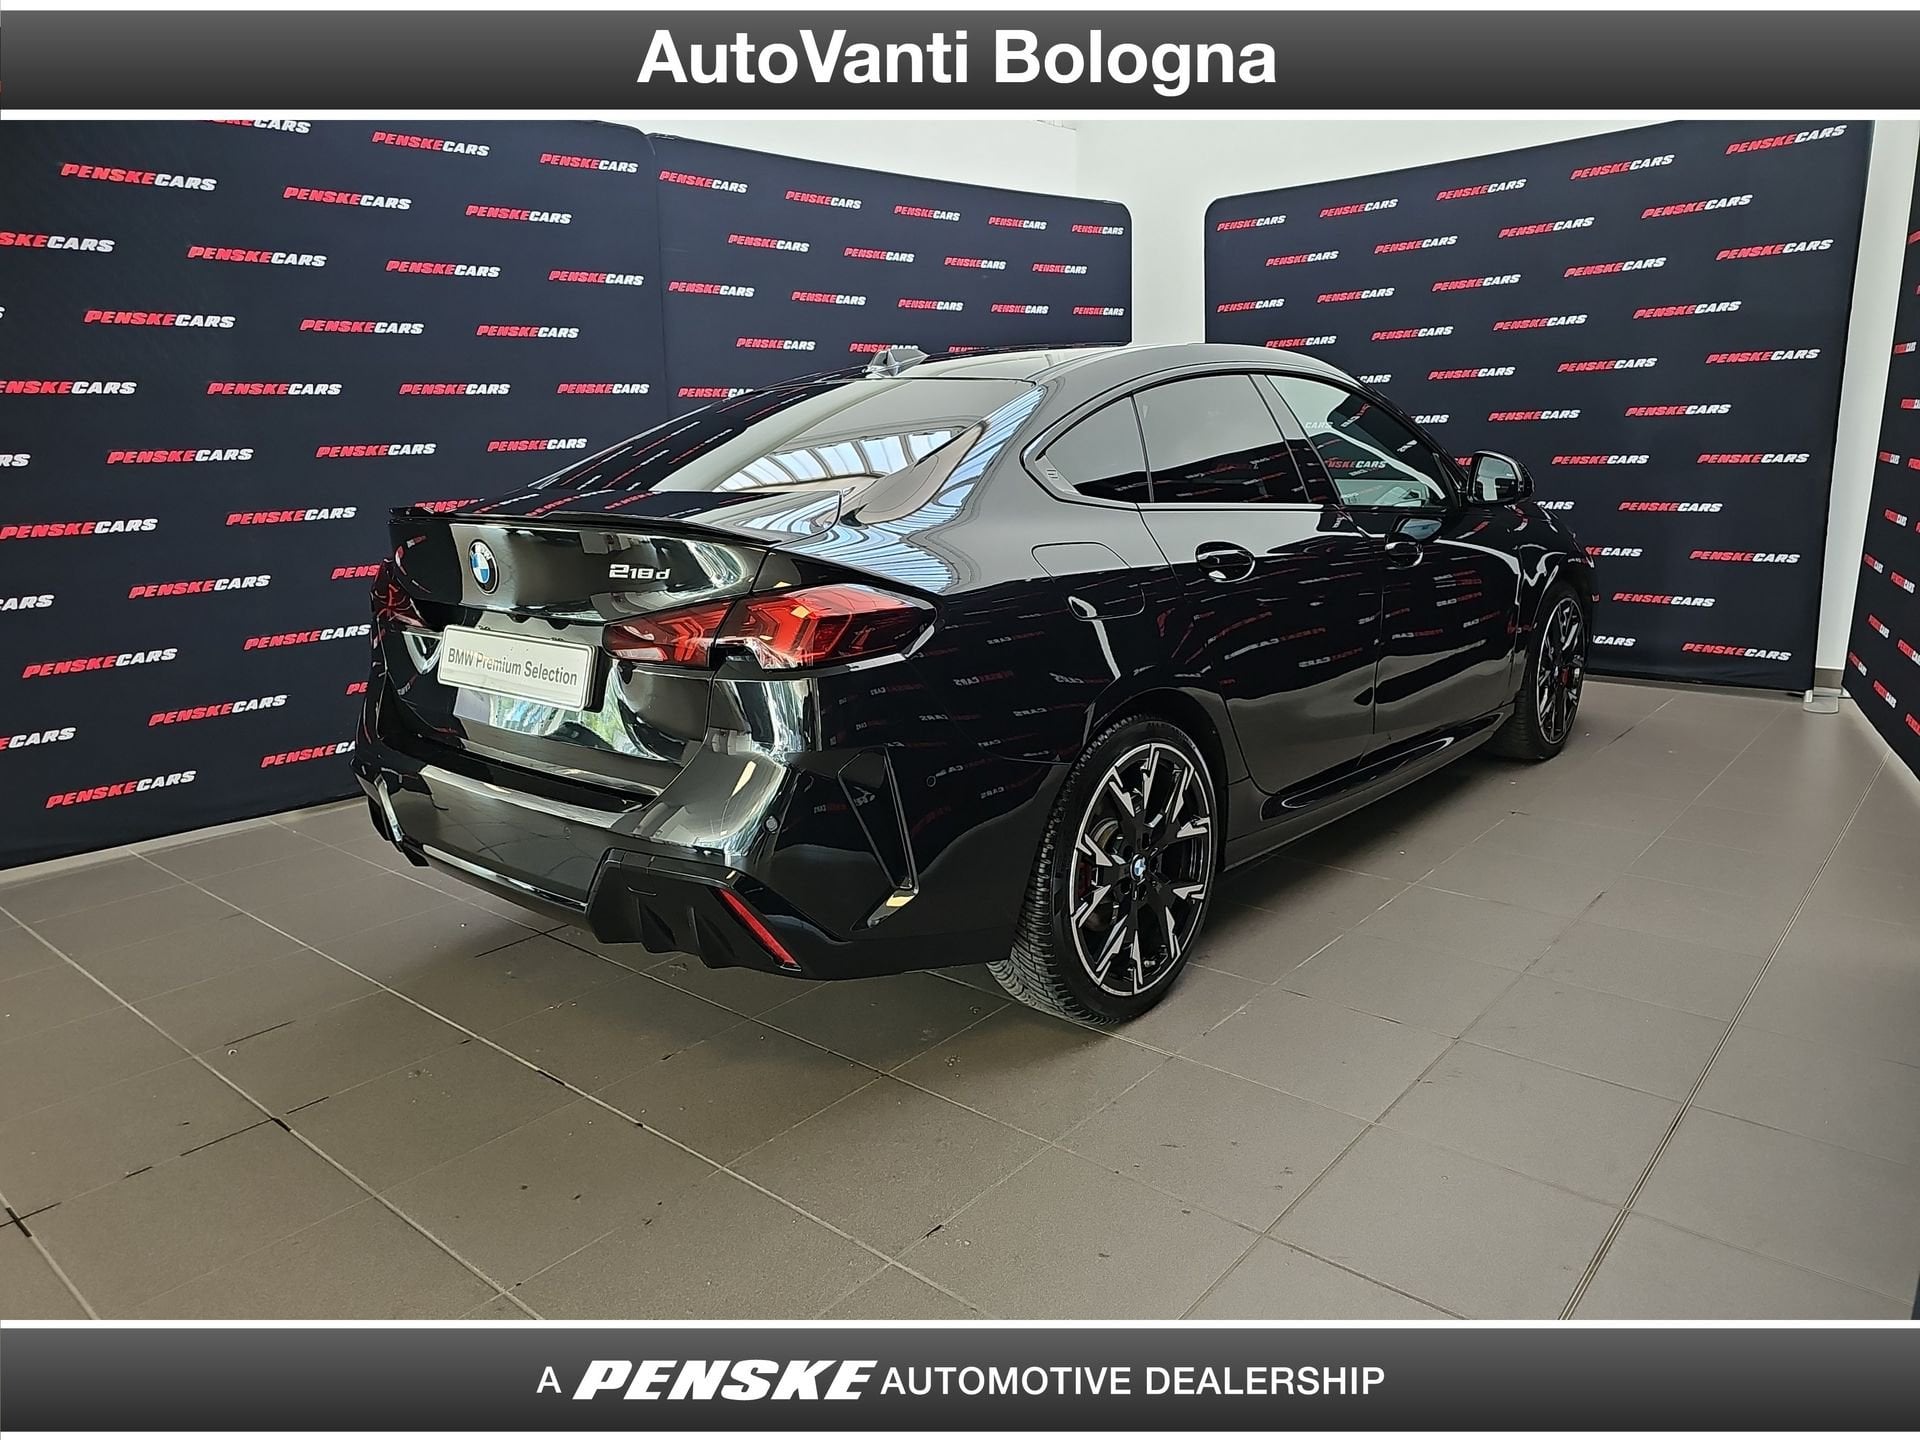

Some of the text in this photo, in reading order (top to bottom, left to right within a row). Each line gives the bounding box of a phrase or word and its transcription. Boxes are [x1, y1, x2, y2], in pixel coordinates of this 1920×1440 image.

[371, 131, 489, 157] PENSKECARS
[1725, 124, 1847, 155] PENSKECARS
[539, 153, 638, 174] PENSKECARS
[1570, 154, 1674, 180] PENSKECARS
[60, 163, 217, 191] PENSKECARS
[658, 170, 747, 194] PENSKECARS
[283, 186, 411, 210] PENSKECARS
[1435, 178, 1526, 201] PENSKECARS
[785, 190, 861, 210] PENSKECARS
[1319, 198, 1398, 218] PENSKECARS
[1641, 194, 1753, 219] PENSKECARS
[465, 204, 571, 225] PENSKECARS
[893, 205, 960, 222] PENSKECARS
[988, 216, 1047, 230] PENSKECARS
[1071, 224, 1123, 236] PENSKECARS
[1216, 214, 1286, 232] PENSKECARS
[1498, 216, 1594, 239] PENSKECARS
[727, 234, 809, 253] PENSKECARS
[1373, 235, 1457, 255] PENSKECARS
[1715, 239, 1833, 261] PENSKECARS
[187, 245, 327, 267] PENSKECARS
[843, 247, 914, 263] PENSKECARS
[943, 256, 1006, 270] PENSKECARS
[1265, 250, 1339, 267] PENSKECARS
[385, 260, 500, 278] PENSKECARS
[1032, 263, 1087, 275] PENSKECARS
[1563, 256, 1666, 278] PENSKECARS
[548, 270, 644, 286] PENSKECARS
[1431, 273, 1521, 292] PENSKECARS
[668, 281, 754, 298] PENSKECARS
[1316, 287, 1394, 304] PENSKECARS
[791, 291, 866, 306] PENSKECARS
[897, 298, 963, 312] PENSKECARS
[1216, 298, 1284, 313] PENSKECARS
[990, 303, 1048, 315] PENSKECARS
[1072, 306, 1124, 316] PENSKECARS
[1632, 300, 1741, 320] PENSKECARS
[83, 309, 235, 329] PENSKECARS
[299, 319, 424, 335] PENSKECARS
[1492, 314, 1587, 331] PENSKECARS
[476, 325, 579, 339] PENSKECARS
[1371, 325, 1453, 341] PENSKECARS
[735, 337, 815, 351] PENSKECARS
[1266, 335, 1337, 348] PENSKECARS
[1705, 348, 1820, 364] PENSKECARS
[1427, 366, 1515, 381] PENSKECARS
[1557, 357, 1657, 373] PENSKECARS
[206, 382, 342, 396] PENSKECARS
[398, 383, 510, 395] PENSKECARS
[556, 383, 649, 394] PENSKECARS
[1488, 409, 1580, 422] PENSKECARS
[1625, 403, 1731, 417] PENSKECARS
[315, 443, 436, 458] PENSKECARS
[487, 438, 587, 452] PENSKECARS
[106, 448, 253, 465] PENSKECARS
[1551, 454, 1649, 465] PENSKECARS
[1696, 453, 1809, 464] PENSKECARS
[225, 506, 356, 526] PENSKECARS
[1618, 502, 1722, 513] PENSKECARS
[0, 518, 158, 540] PENSKECARS
[1689, 550, 1800, 564] PENSKECARS
[609, 563, 671, 580] 218d
[128, 574, 270, 599] PENSKECARS
[1612, 592, 1715, 607] PENSKECARS
[243, 623, 370, 651] PENSKECARS
[1682, 642, 1791, 661] PENSKECARS
[22, 647, 177, 679] PENSKECARS
[448, 647, 578, 686] BMW Premium Selection
[148, 694, 287, 727] PENSKECARS
[45, 770, 196, 809] PENSKECARS
